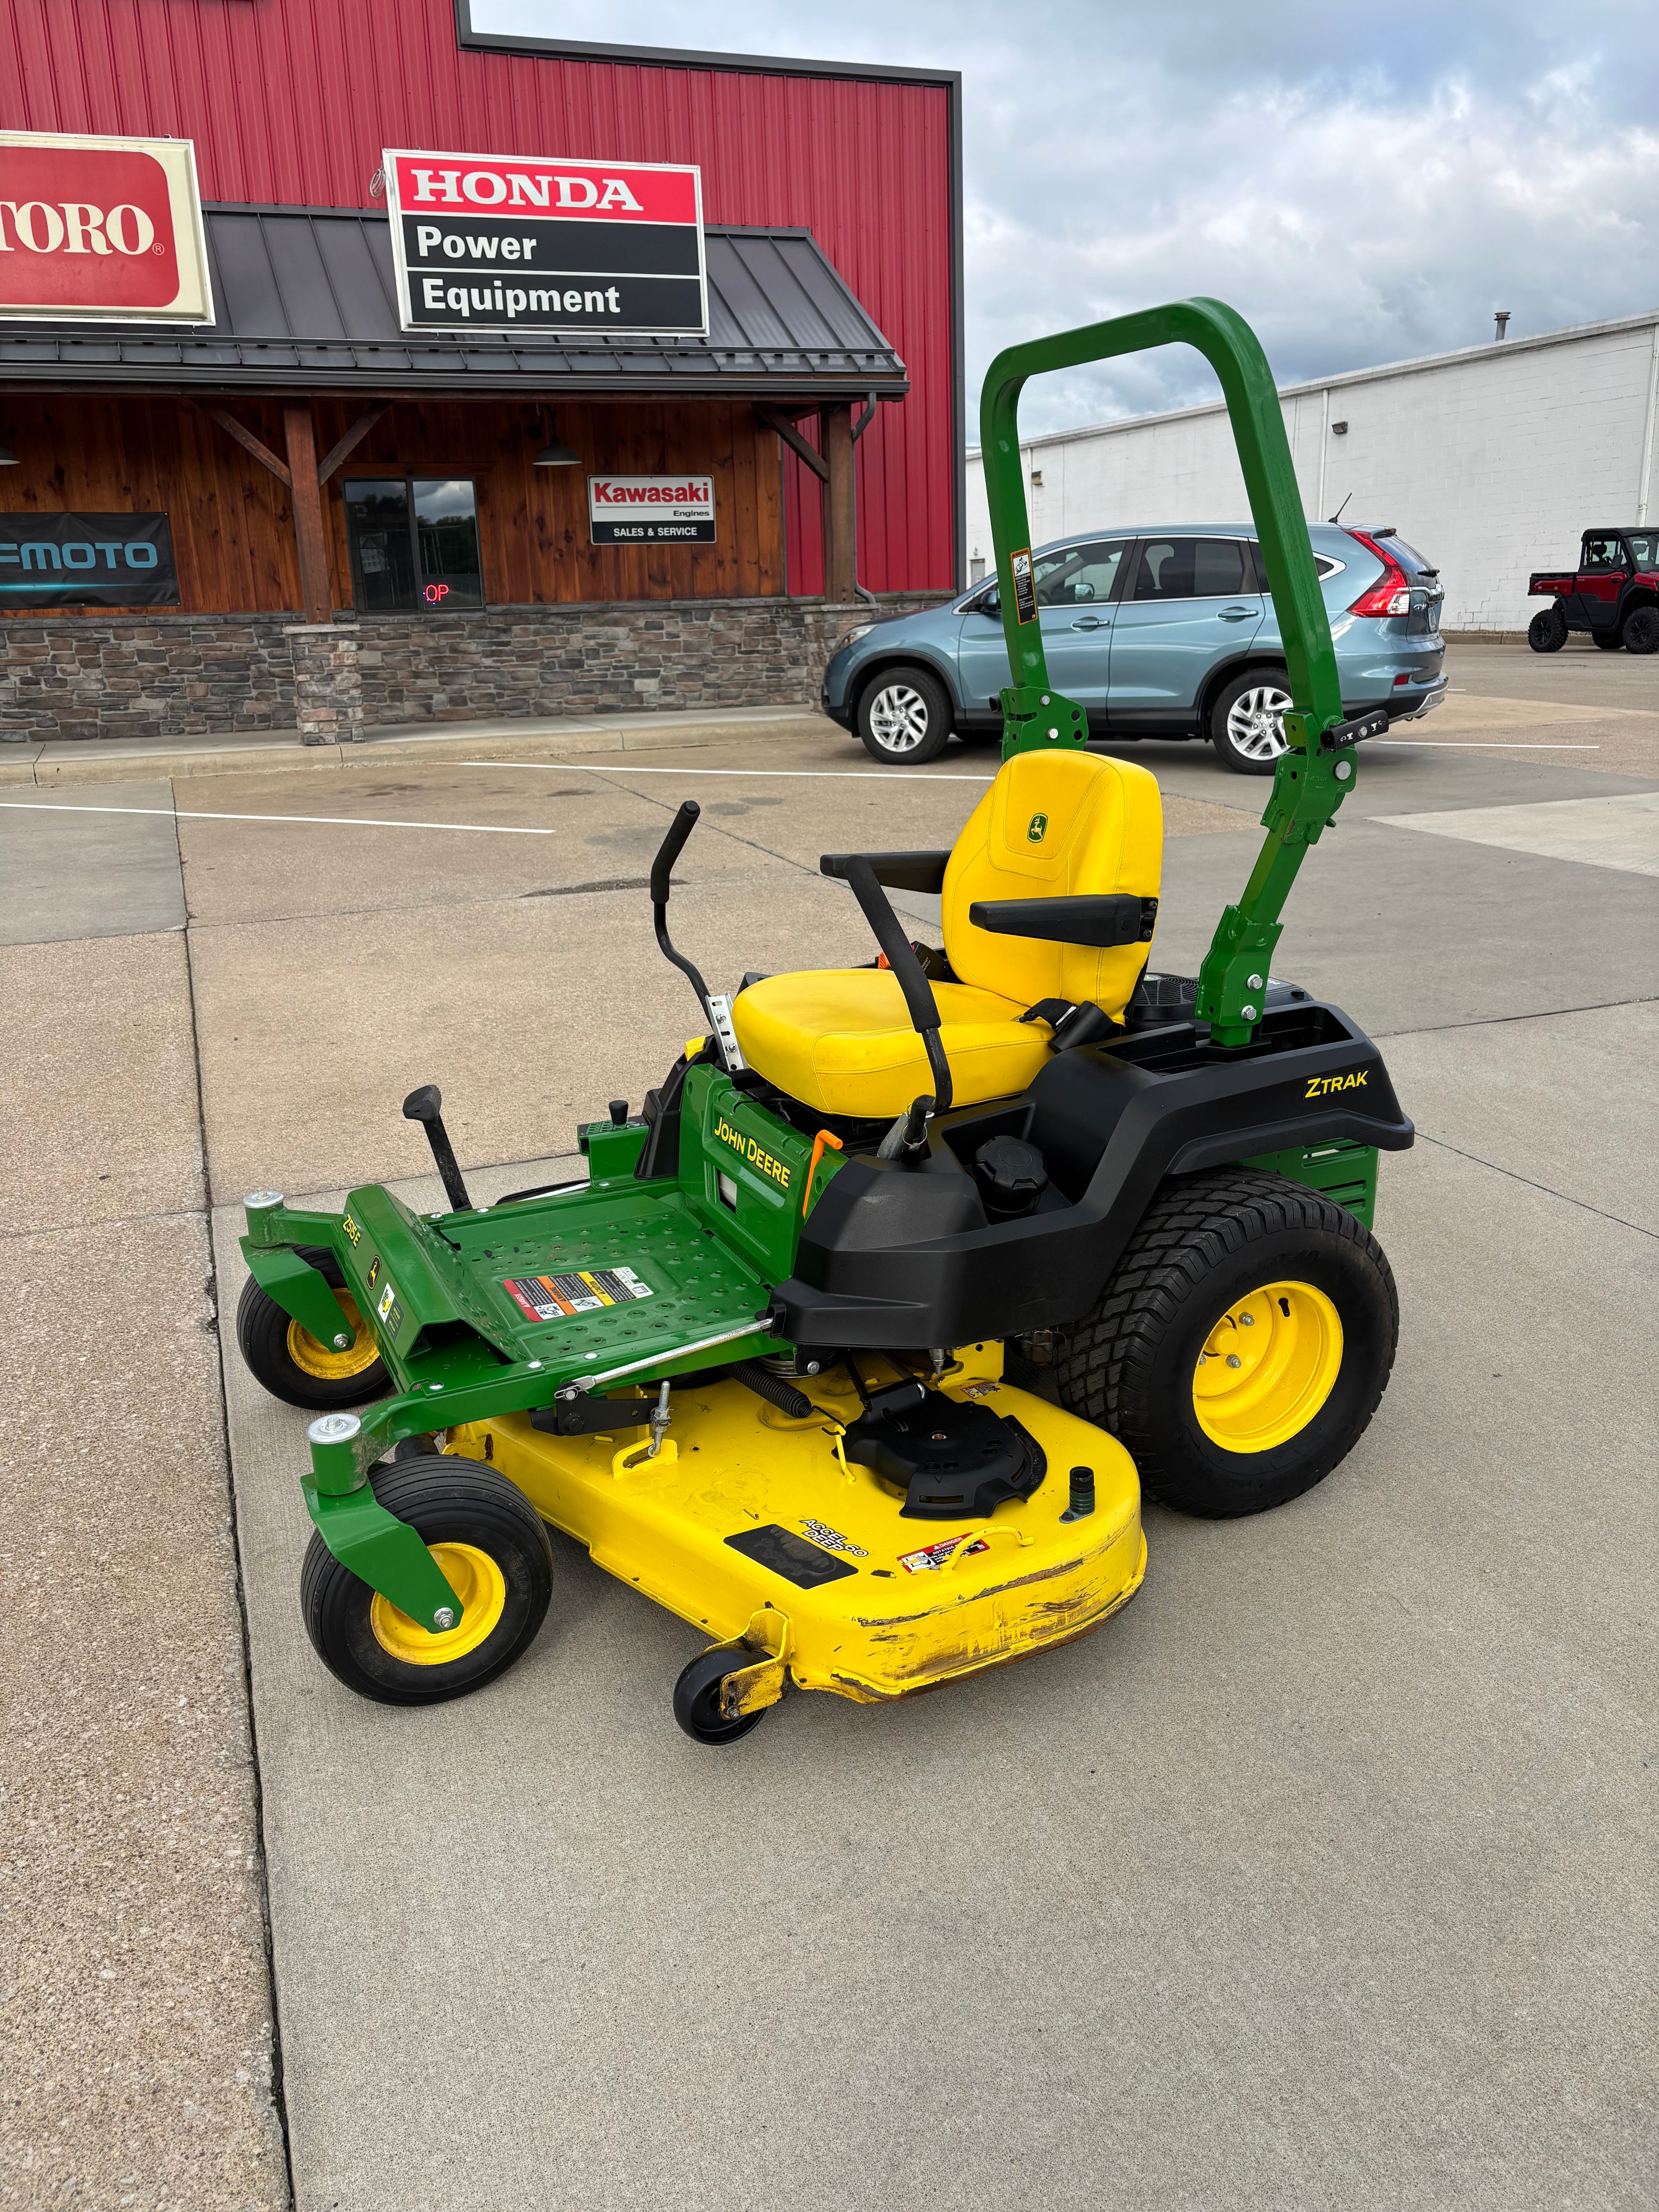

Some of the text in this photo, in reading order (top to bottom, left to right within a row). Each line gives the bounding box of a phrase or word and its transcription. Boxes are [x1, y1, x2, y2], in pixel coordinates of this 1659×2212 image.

[411, 169, 644, 211] HONDA
[417, 225, 537, 260] Power
[422, 278, 620, 318] Equipment
[594, 483, 709, 503] Kawasaki
[613, 527, 697, 537] SALES & SERVICE
[1305, 1070, 1369, 1098] ZTRAK
[714, 1116, 790, 1188] JOHN DEERE
[799, 1519, 869, 1557] ACCEL 60
[802, 1530, 844, 1551] DEEP
[940, 1537, 963, 1547] DANGER
